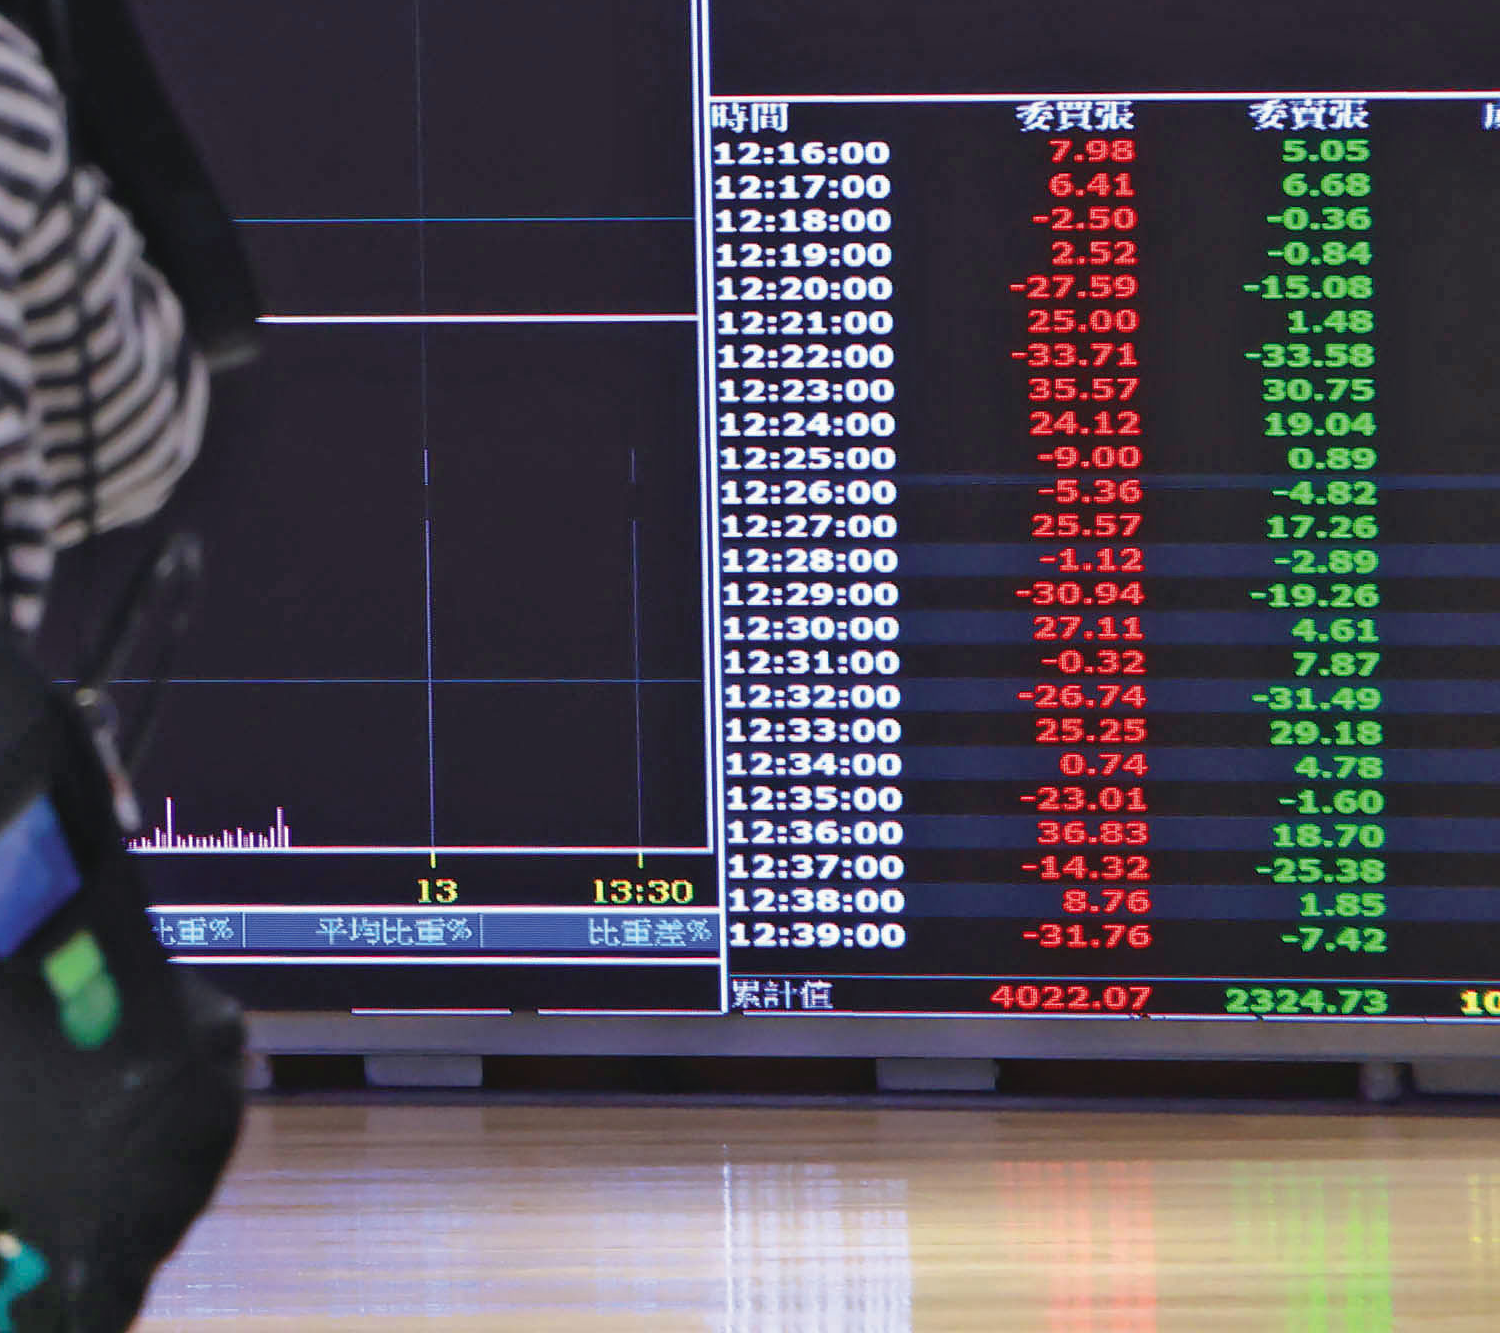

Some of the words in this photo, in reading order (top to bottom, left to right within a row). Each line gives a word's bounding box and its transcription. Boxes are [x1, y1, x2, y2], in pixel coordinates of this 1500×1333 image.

[710, 102, 789, 133] 時間
[713, 141, 890, 165] 12:16:00
[1048, 138, 1137, 164] 7.98
[1282, 138, 1370, 163] 5.05
[418, 879, 455, 902] 13
[595, 879, 693, 902] 13:30
[729, 922, 906, 948] 12:39:00
[1022, 923, 1153, 949] -31.76
[1281, 927, 1387, 953] -7.42
[984, 984, 1157, 1016] 4022.07
[1224, 987, 1389, 1015] 2324.73
